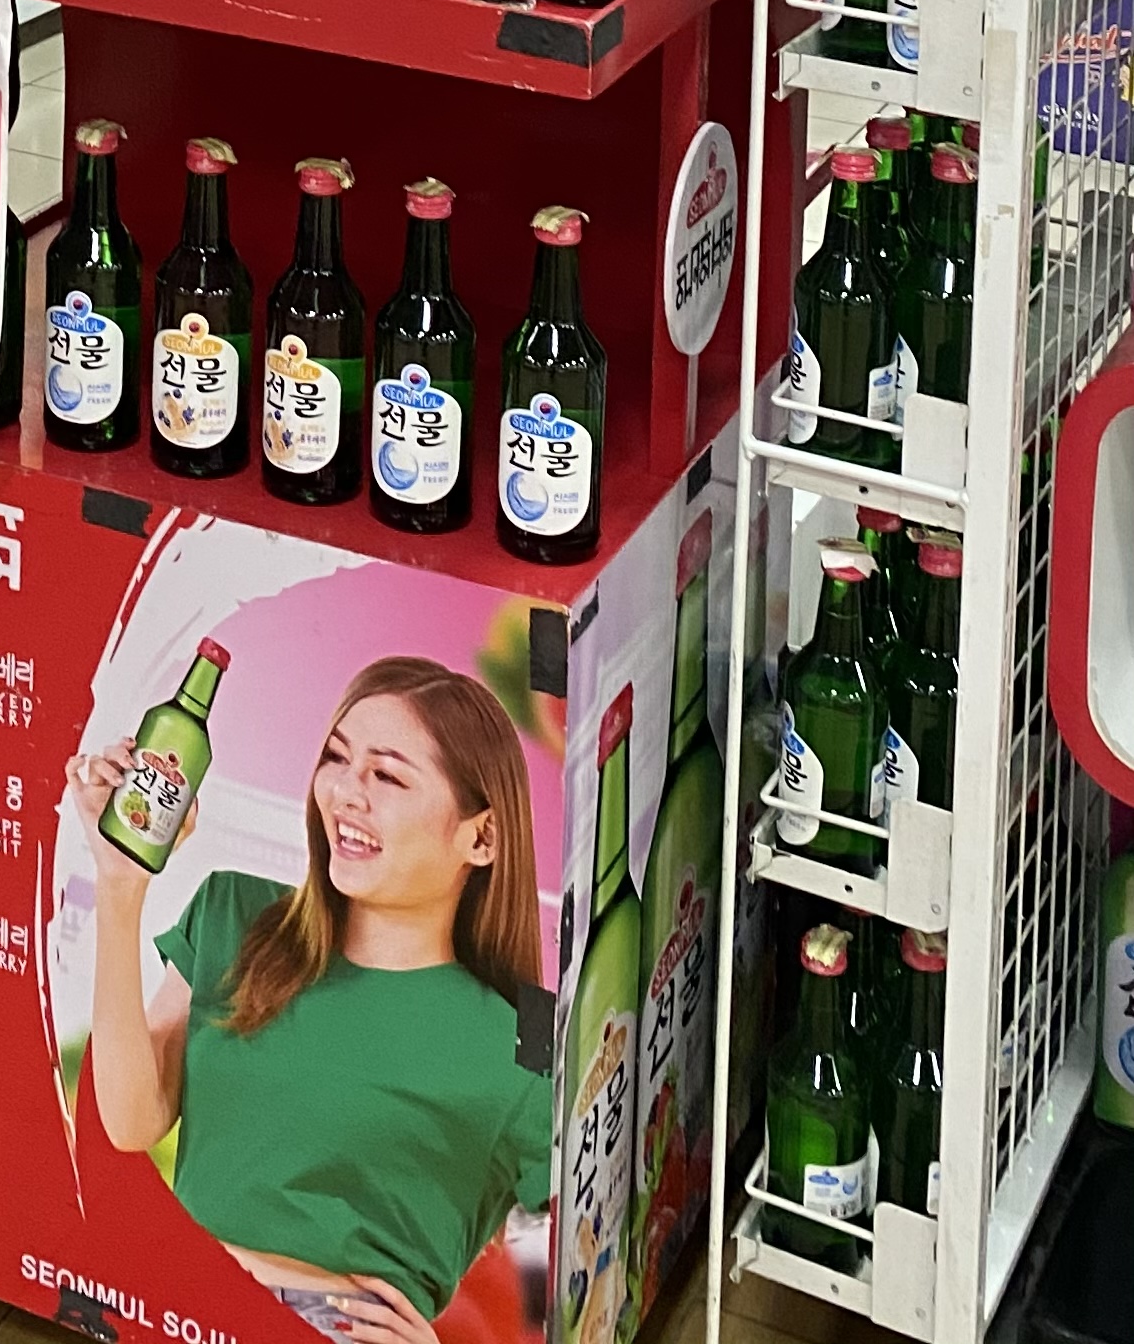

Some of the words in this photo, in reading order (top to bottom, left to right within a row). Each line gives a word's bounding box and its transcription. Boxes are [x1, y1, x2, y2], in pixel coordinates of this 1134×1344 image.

[512, 415, 572, 438] SEONMUL
[507, 432, 579, 477] 선물
[21, 1253, 153, 1329] SEONMUL
